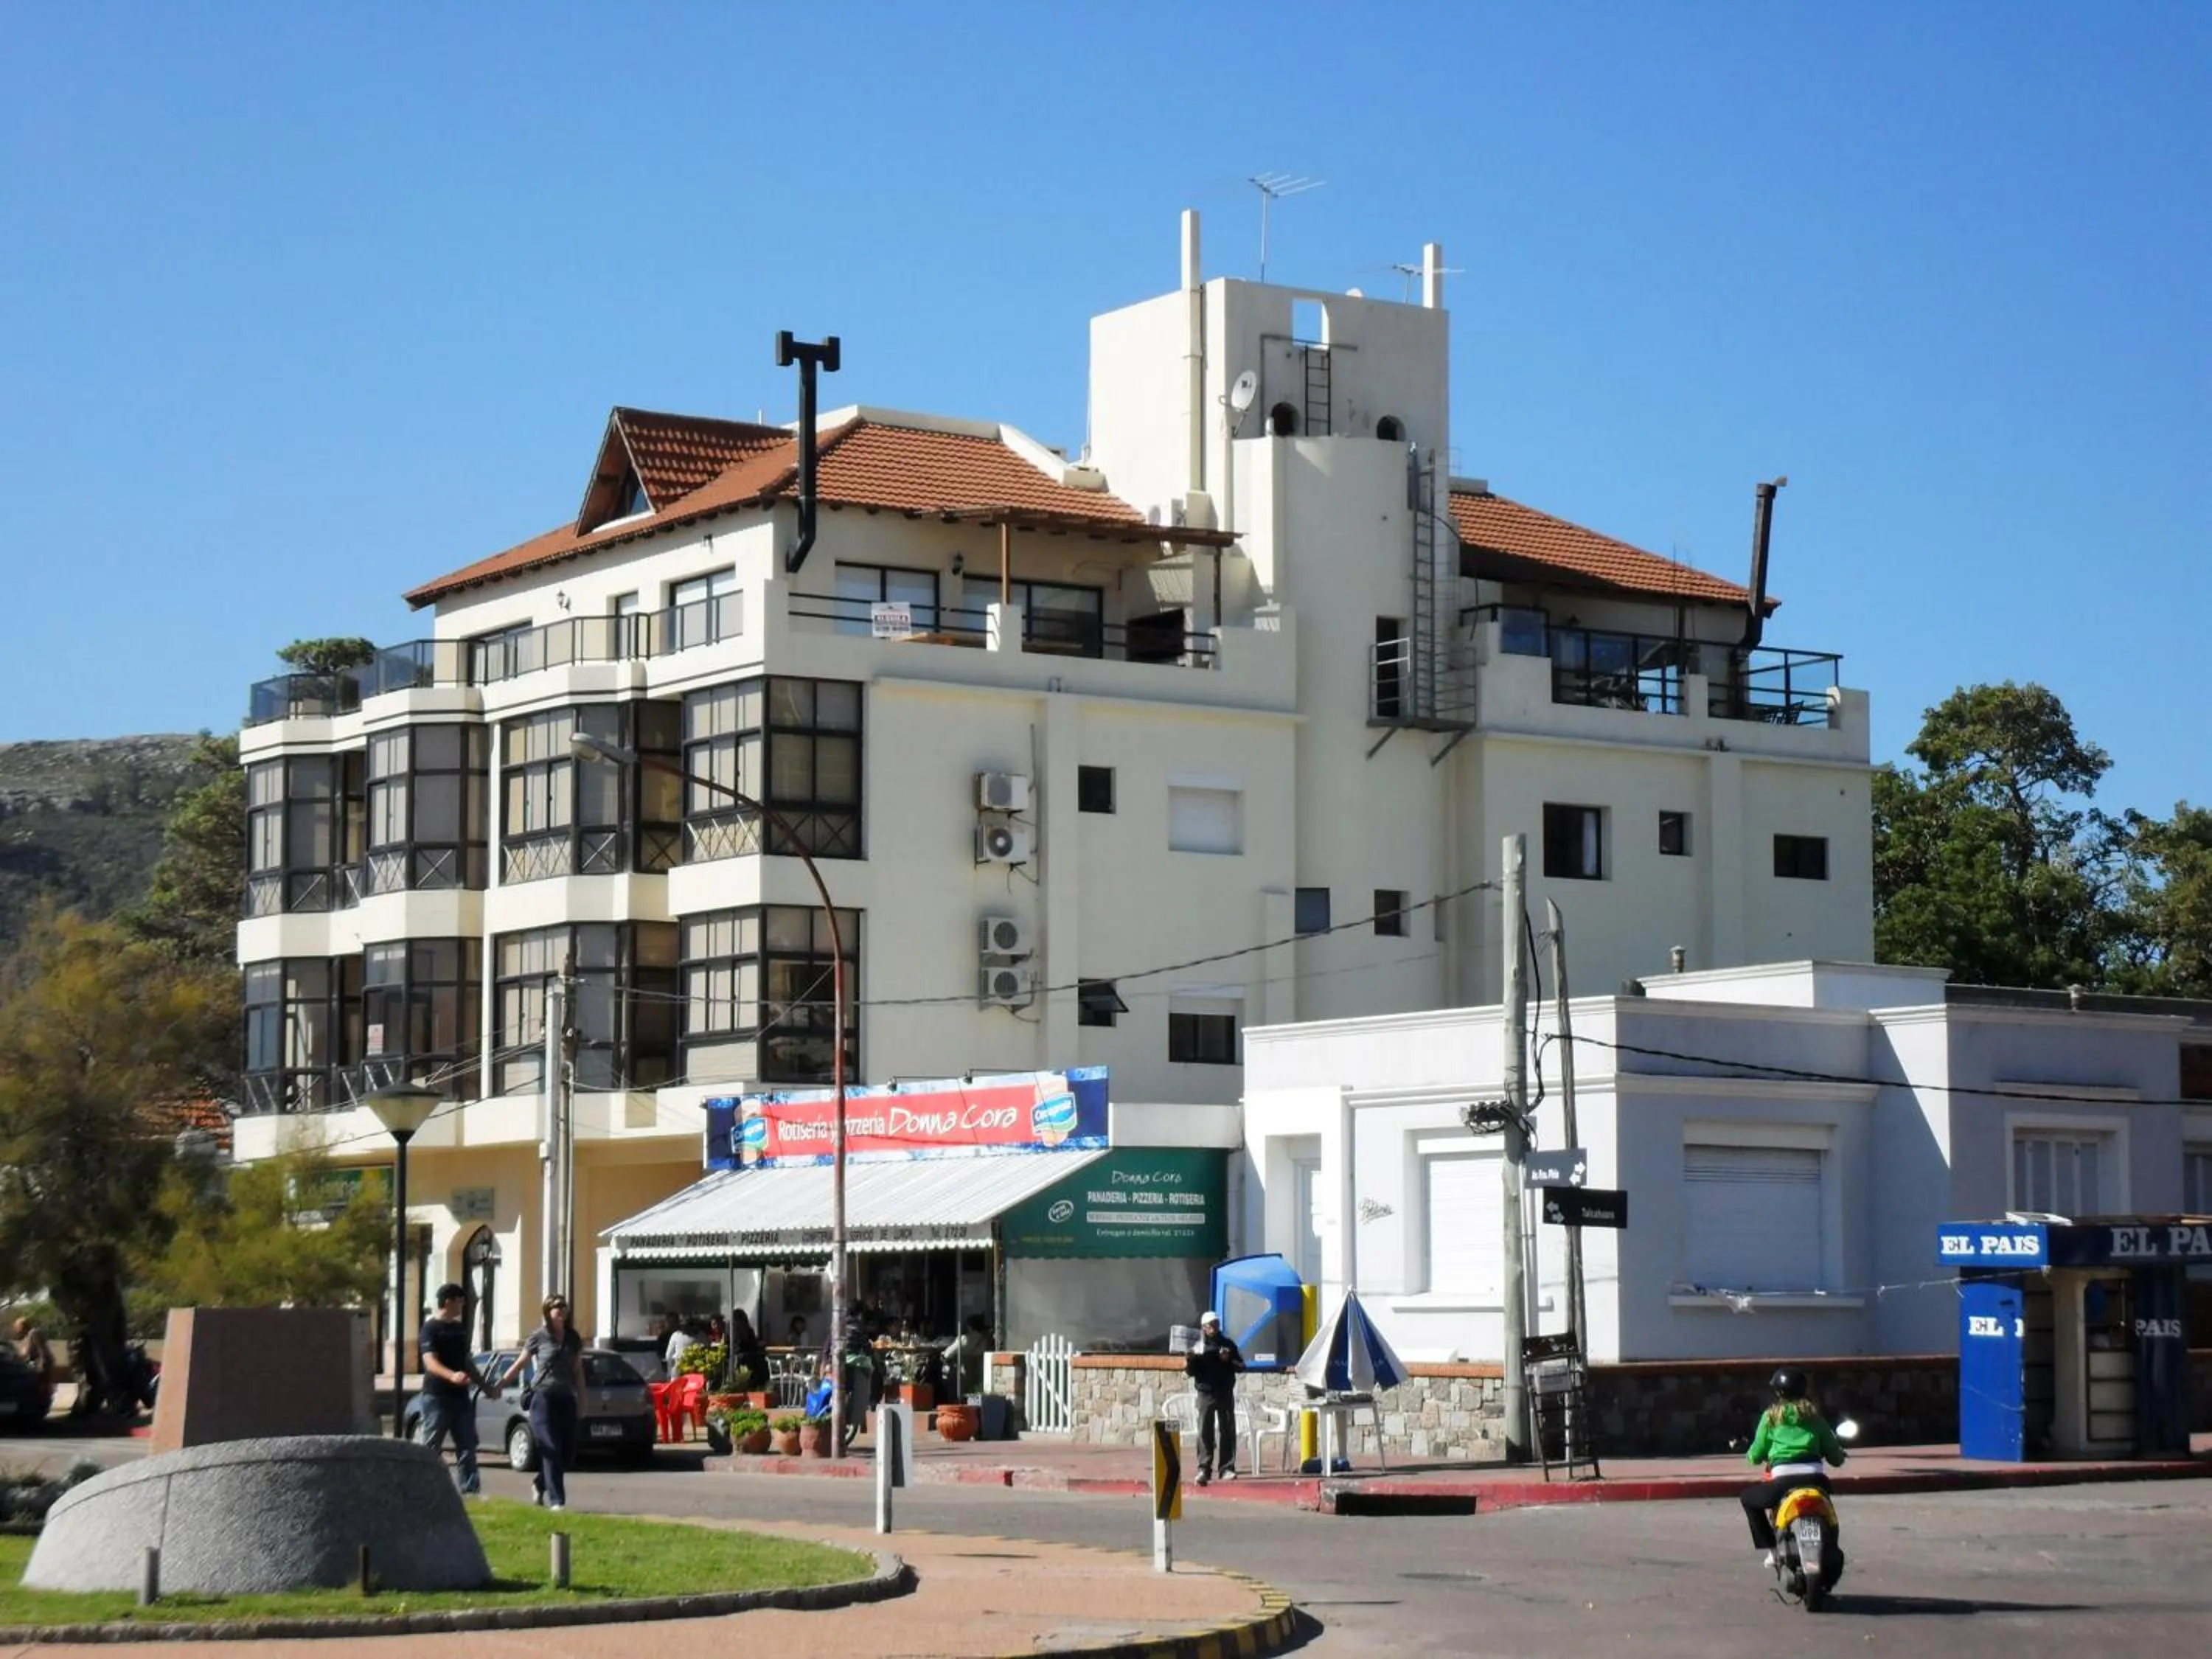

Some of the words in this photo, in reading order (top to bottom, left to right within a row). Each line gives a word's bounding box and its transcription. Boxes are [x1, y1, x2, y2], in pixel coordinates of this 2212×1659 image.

[889, 1107, 957, 1135] Donna
[961, 1104, 1018, 1130] Cora
[1111, 1170, 1150, 1184] Donna
[1152, 1170, 1182, 1184] Cora
[1133, 1192, 1164, 1204] PIZZERIA
[630, 1234, 675, 1248] PANADERIA
[741, 1232, 779, 1245] PIZZERIA
[1941, 1236, 1975, 1255] EL
[1980, 1235, 2040, 1255] PAIS
[2110, 1227, 2157, 1256] EL
[1969, 1316, 2004, 1336] EL
[2135, 1319, 2181, 1338] PAIS
